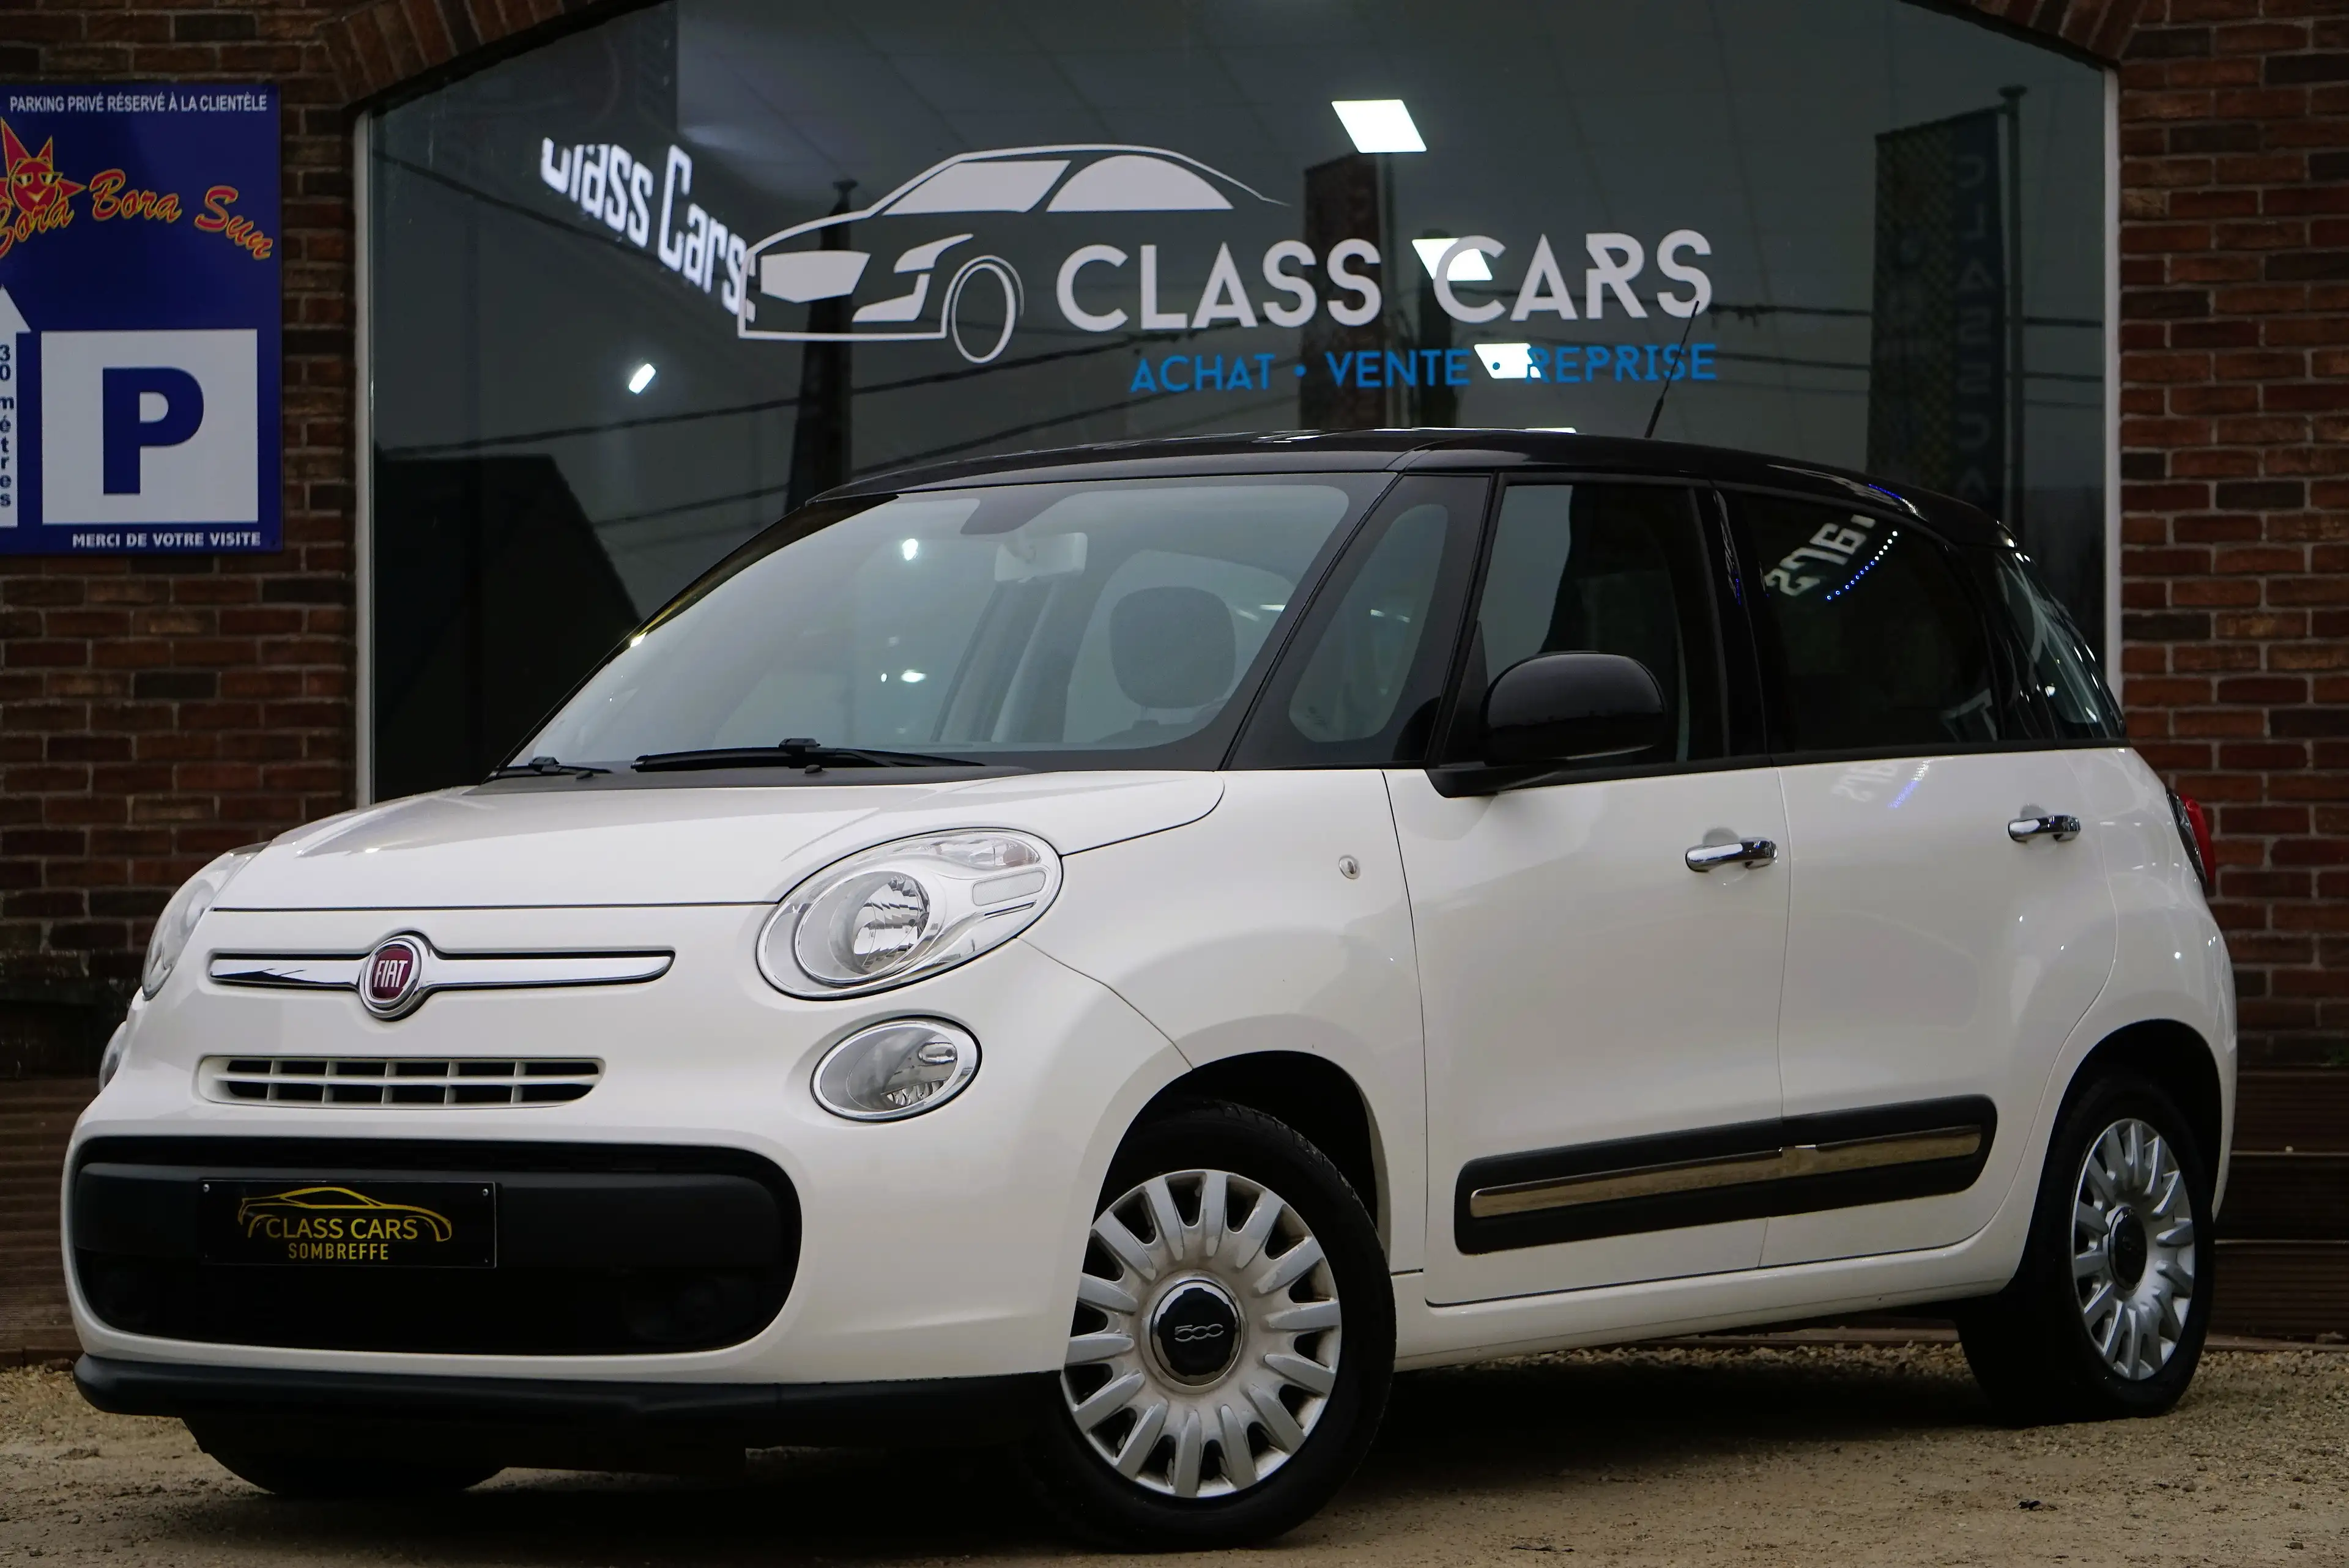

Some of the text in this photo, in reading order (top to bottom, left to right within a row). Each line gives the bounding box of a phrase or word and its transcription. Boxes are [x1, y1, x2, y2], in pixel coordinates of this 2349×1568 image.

[10, 91, 267, 113] PARKING PRIVÉ RÉSERVÉ À LA CLIENTÈLE
[89, 168, 182, 224] Bora
[194, 185, 273, 260] Sun
[658, 144, 756, 323] Cars
[1056, 229, 1713, 332] CLASS CARS
[1129, 343, 1717, 394] ACHAT VENTE REPRISE
[103, 366, 204, 495] P
[72, 531, 261, 548] MERCI DE VOTRE VISITE
[374, 960, 408, 988] FIAT
[265, 1218, 418, 1240] CLASS CARS
[288, 1243, 388, 1260] SOMBREFFE
[1174, 1324, 1223, 1342] 500
